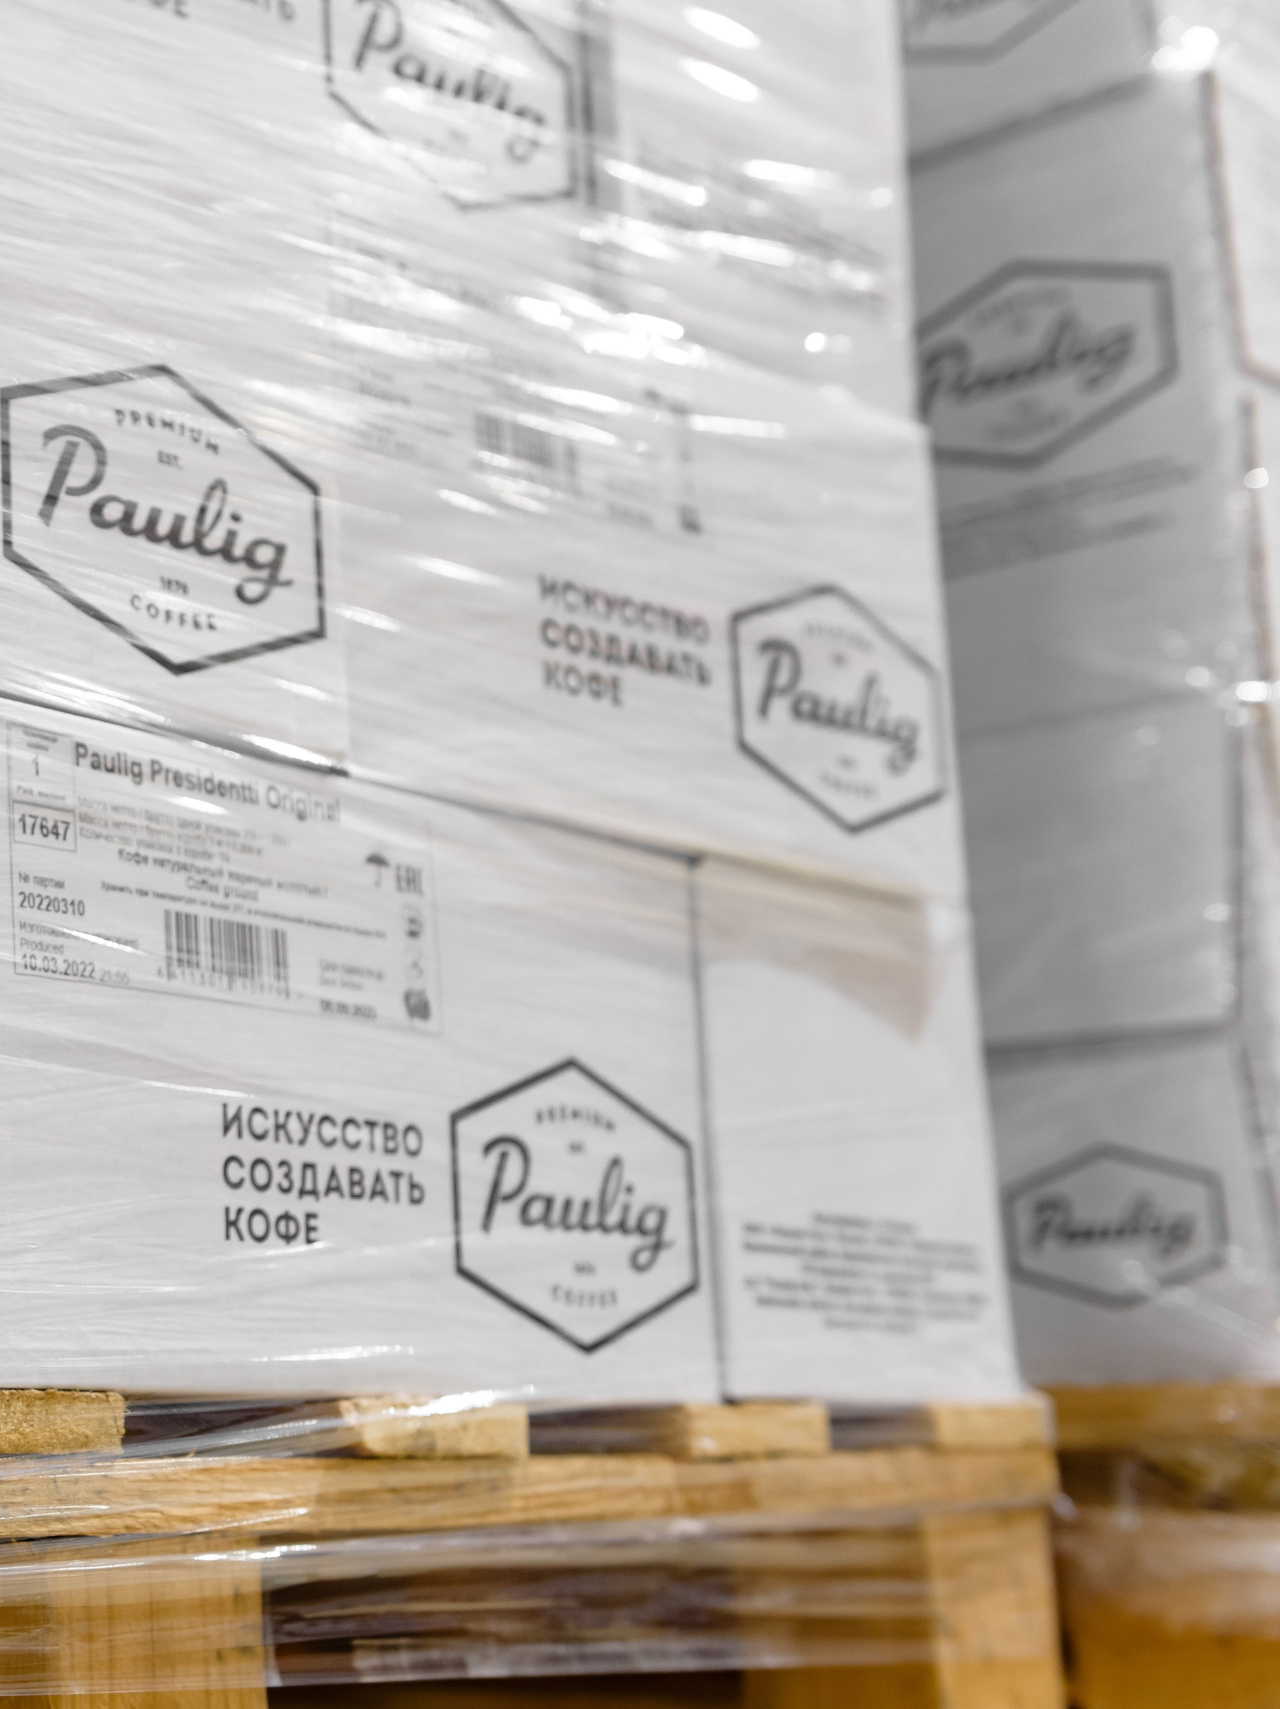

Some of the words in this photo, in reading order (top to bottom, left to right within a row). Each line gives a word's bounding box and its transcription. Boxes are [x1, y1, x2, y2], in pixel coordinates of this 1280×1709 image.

[114, 408, 220, 456] PREMIUM
[37, 424, 294, 605] Paulig
[130, 595, 219, 632] COFFEE
[539, 616, 712, 688] СОЗДАВАТЬ
[756, 635, 921, 777] Paulig
[75, 741, 144, 786] Paulig
[149, 759, 260, 805] Presidentti
[266, 785, 341, 822] Original
[18, 812, 71, 842] 17647
[19, 891, 86, 917] 20220310
[20, 937, 65, 956] Produced
[21, 953, 97, 980] 10.03.2022
[221, 1102, 423, 1158] ИСКУССТВО
[222, 1155, 425, 1206] СОЗДАВАТЬ
[482, 1134, 675, 1274] Paulig
[224, 1206, 320, 1245] КОФЕ
